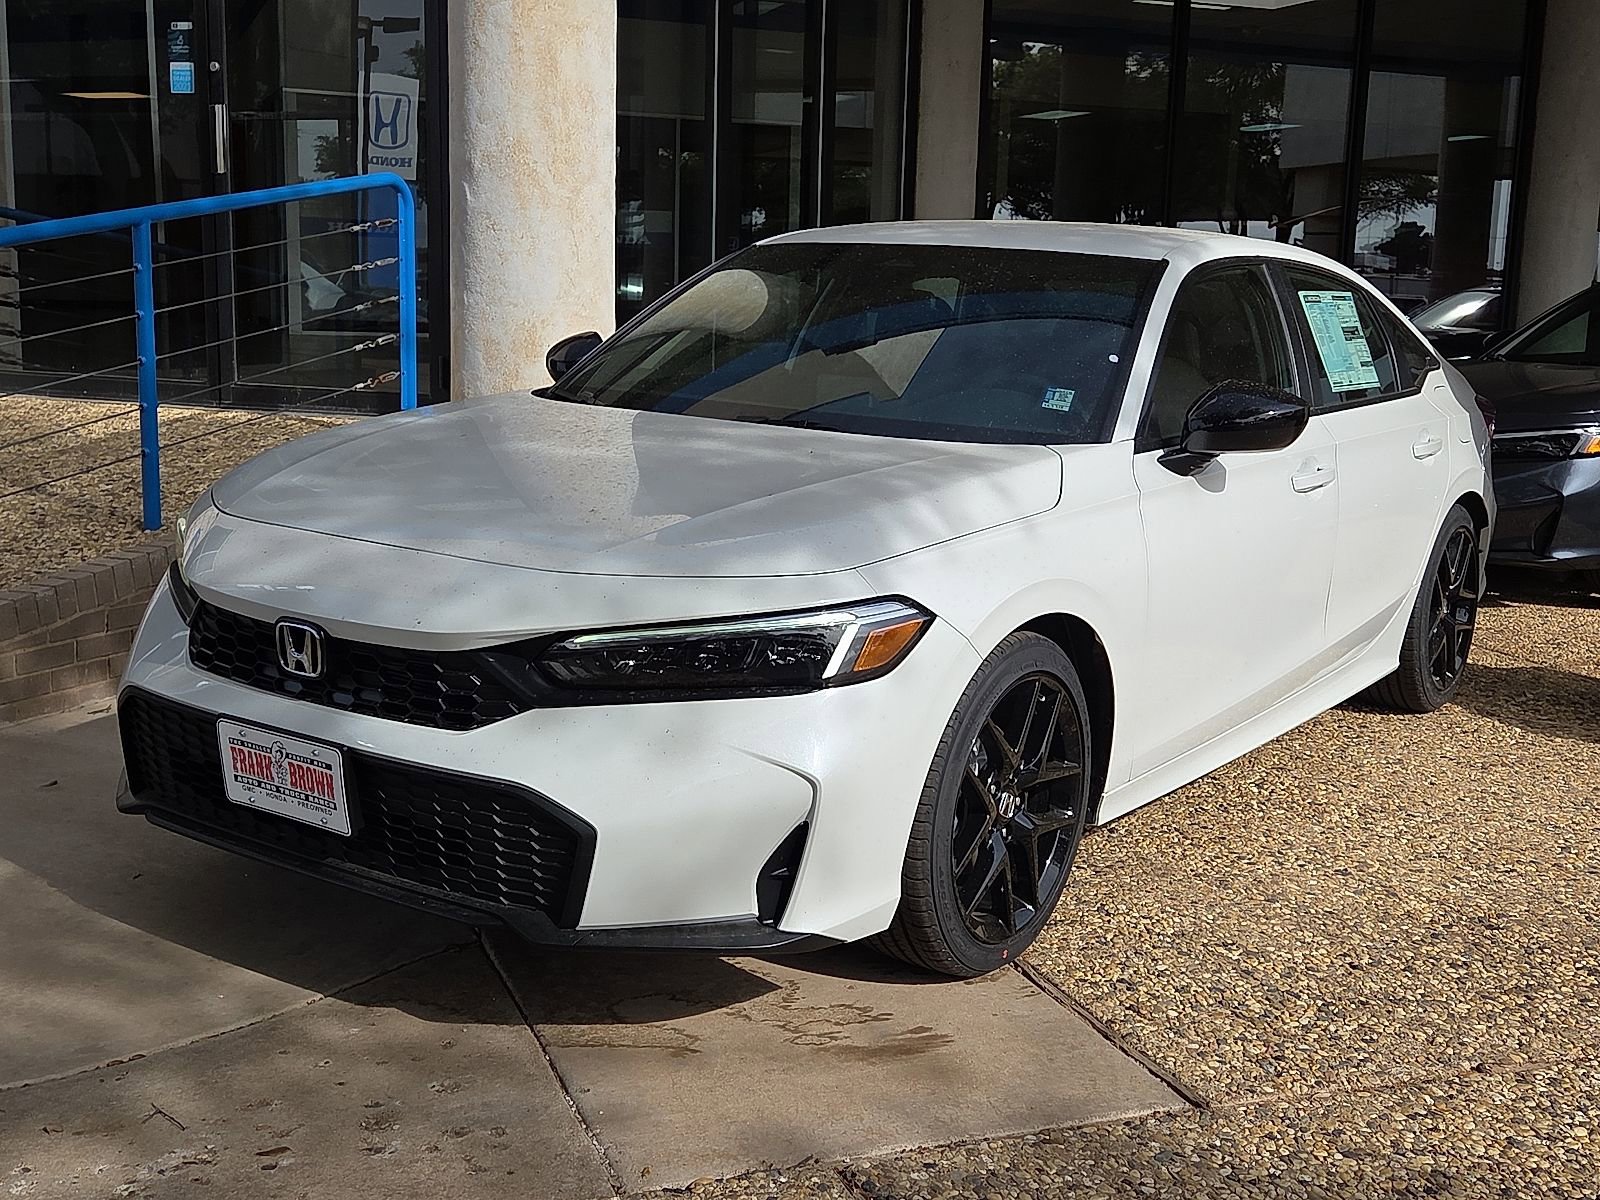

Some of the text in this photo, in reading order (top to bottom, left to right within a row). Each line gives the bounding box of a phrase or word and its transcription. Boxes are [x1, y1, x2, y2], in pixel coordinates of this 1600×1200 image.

[230, 746, 335, 801] FRANK BROWN
[237, 776, 335, 809] AUTO AND TRUCK RANCH
[242, 785, 333, 816] GMC HONDA PREOWNED
